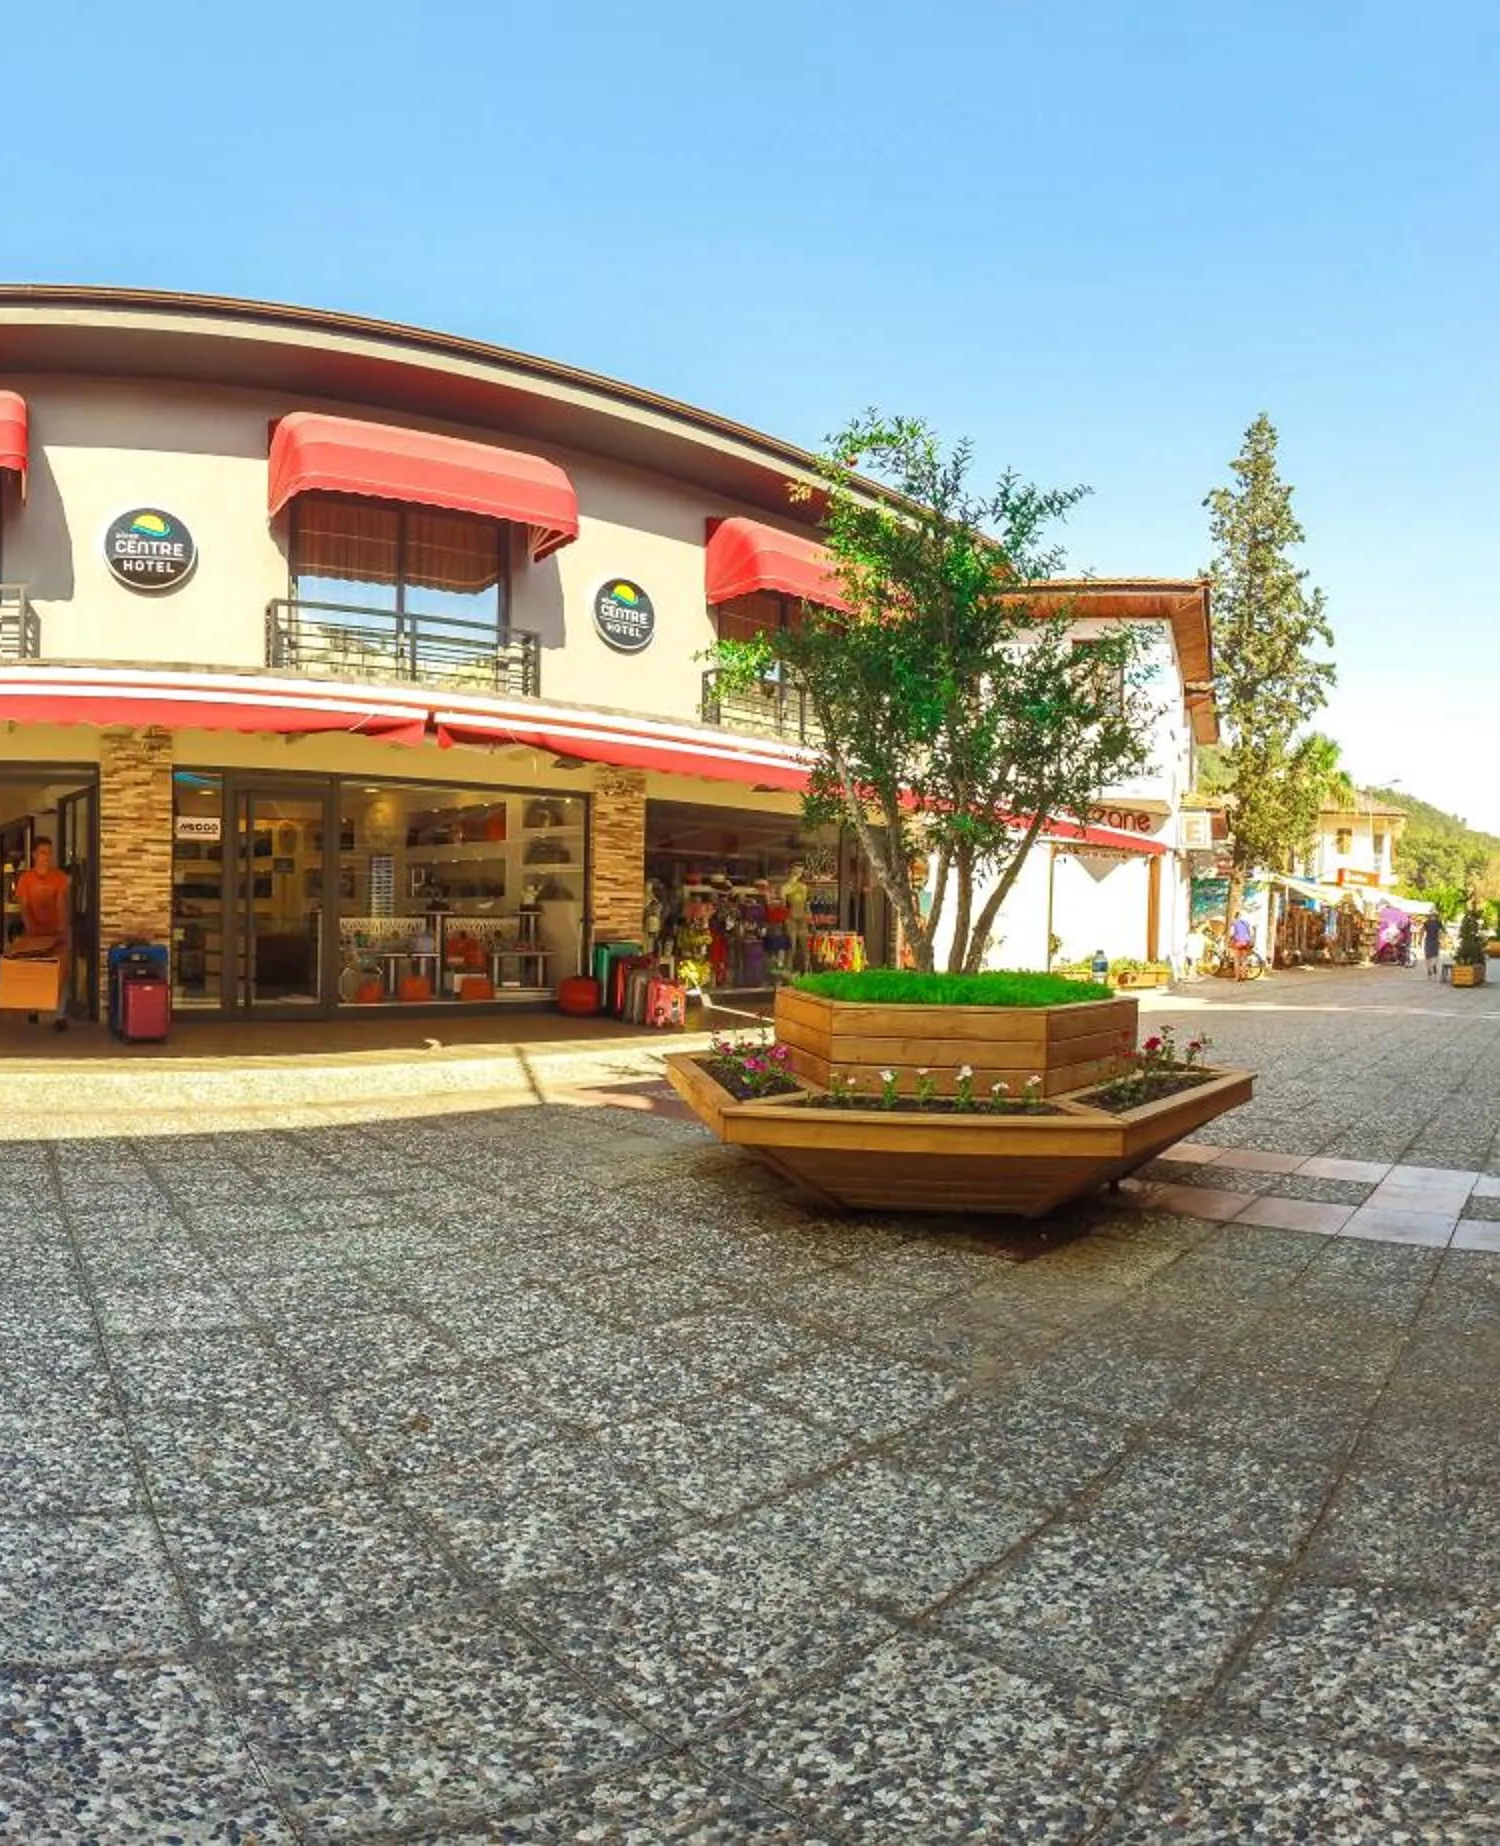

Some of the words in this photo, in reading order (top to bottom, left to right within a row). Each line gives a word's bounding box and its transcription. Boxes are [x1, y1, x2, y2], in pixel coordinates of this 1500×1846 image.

[115, 540, 185, 557] CENTRE
[123, 560, 175, 573] HOTEL
[601, 604, 649, 625] CENTRE
[606, 622, 642, 639] HOTEL
